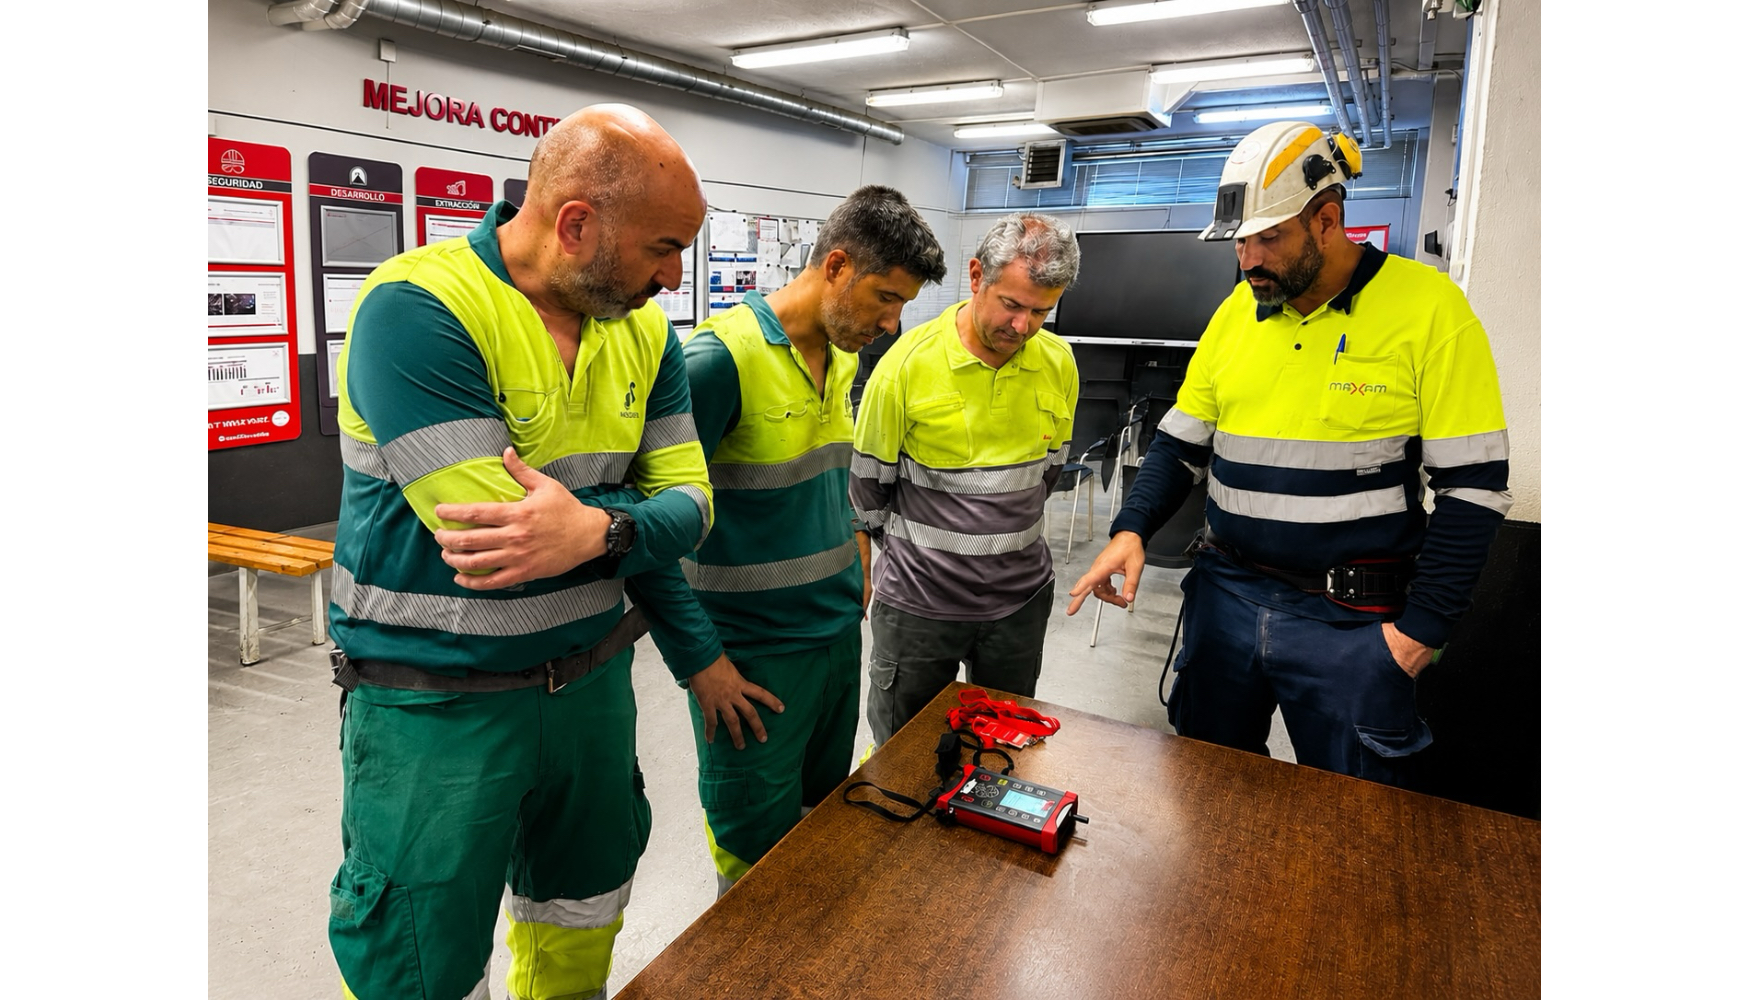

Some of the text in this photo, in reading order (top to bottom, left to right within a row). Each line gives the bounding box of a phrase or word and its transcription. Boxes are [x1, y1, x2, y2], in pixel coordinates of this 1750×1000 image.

[363, 78, 561, 138] MEJORA CONT
[208, 176, 263, 190] SEGURIDAD
[330, 188, 385, 202] DESARROLLO
[435, 199, 480, 210] EXTRACCIÓN
